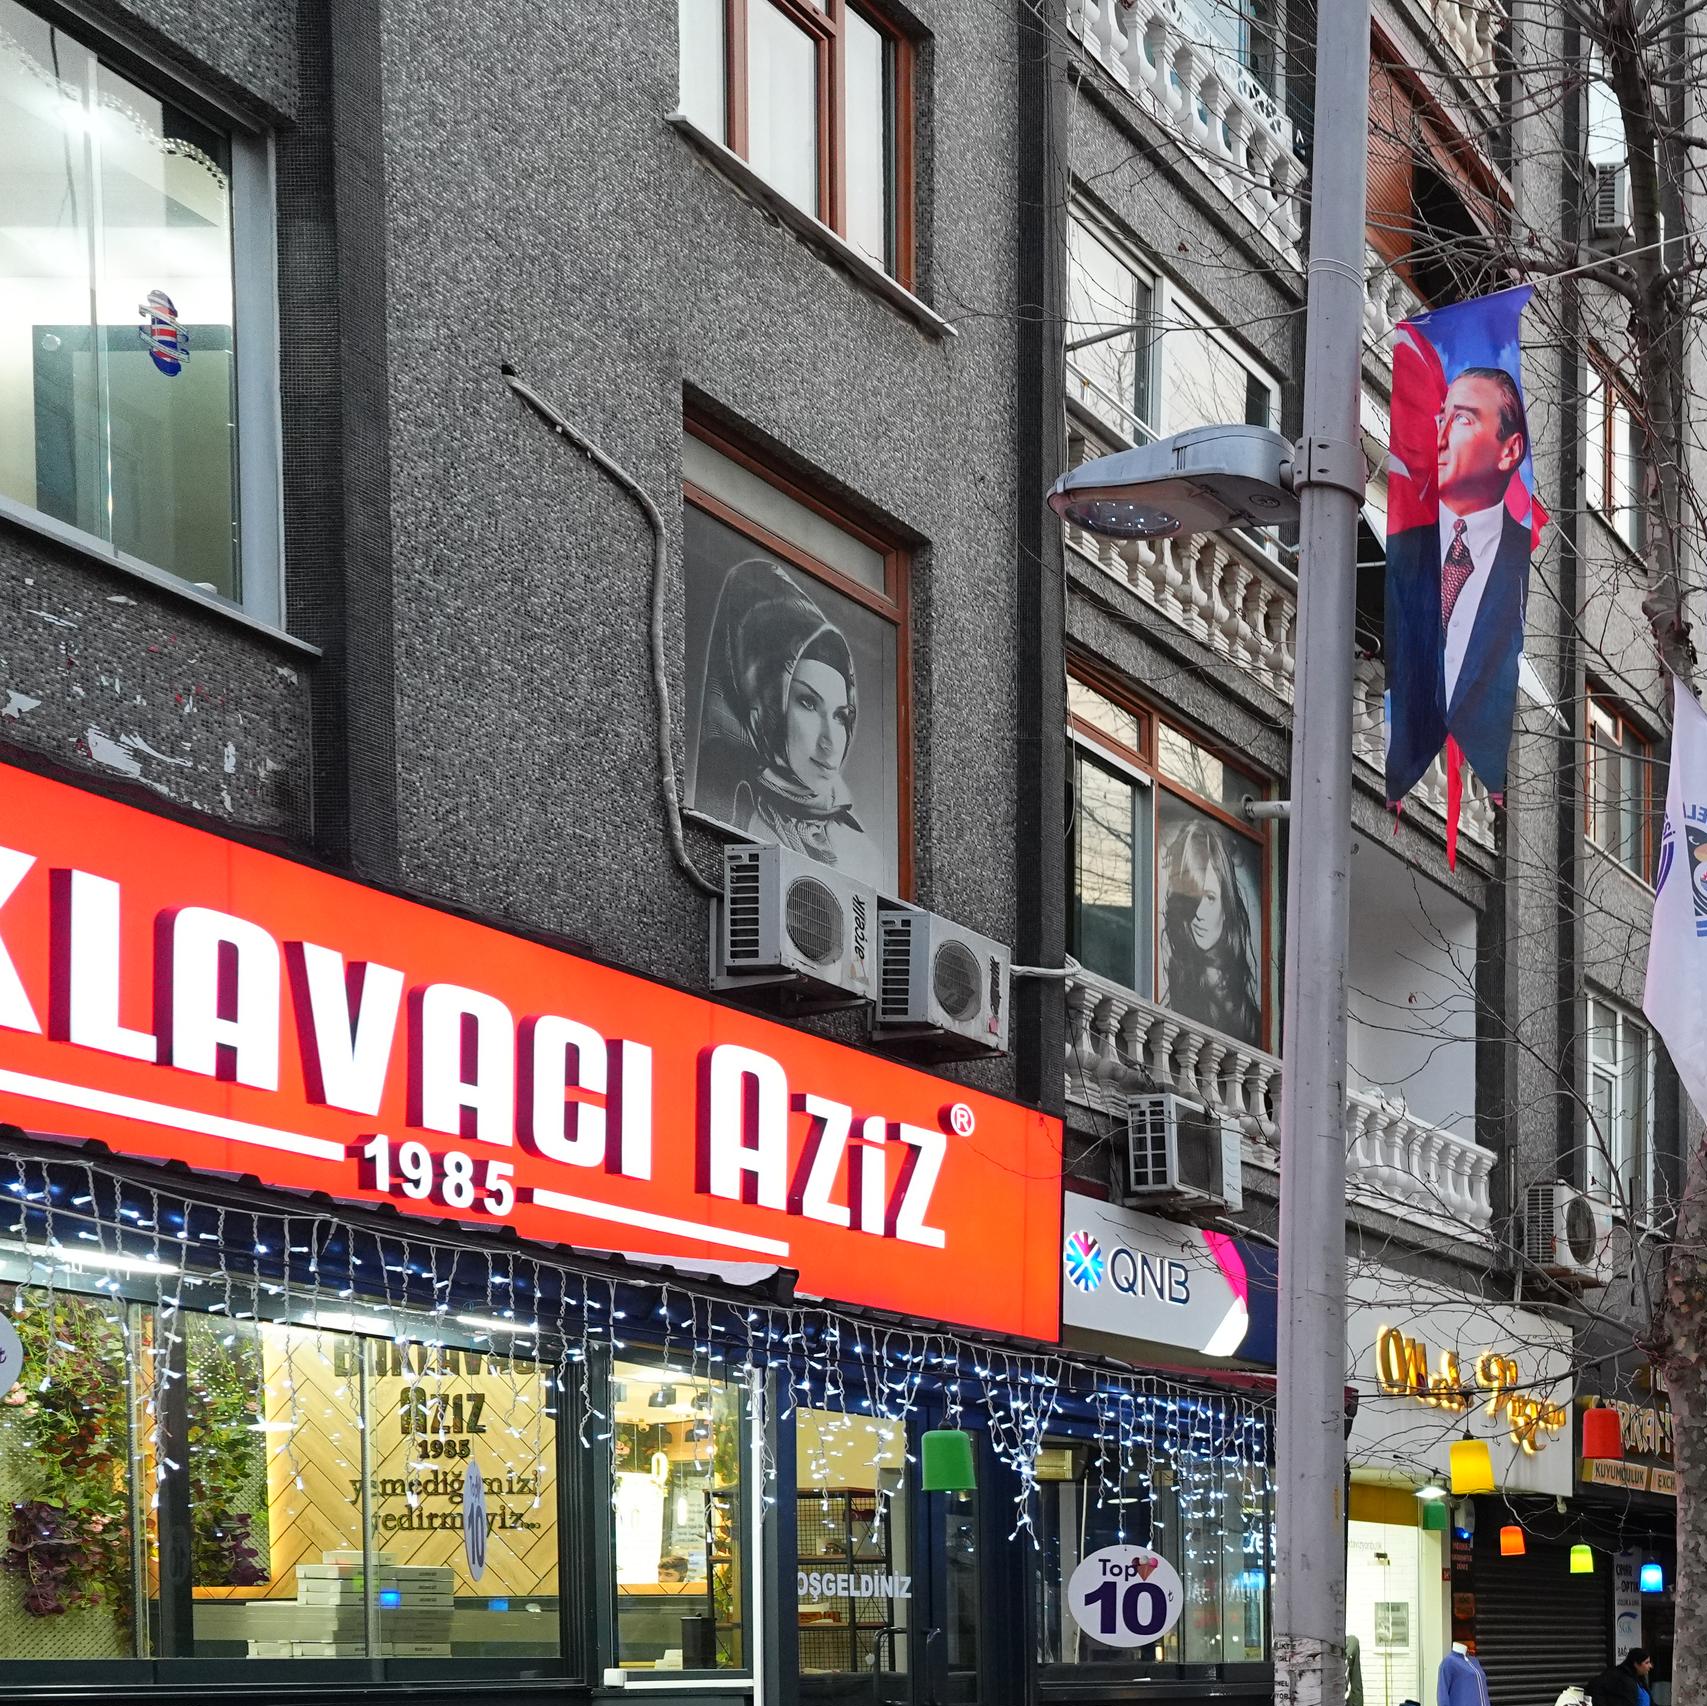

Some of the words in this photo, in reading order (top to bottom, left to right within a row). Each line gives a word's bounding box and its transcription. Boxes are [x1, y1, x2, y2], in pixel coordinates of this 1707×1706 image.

[363, 1134, 516, 1218] 1985
[1108, 1246, 1190, 1306] QNB
[417, 1438, 471, 1459] 1985
[1594, 1462, 1645, 1485] KUYUMCULUK
[1098, 1558, 1138, 1582] Top
[1084, 1581, 1168, 1636] 10
